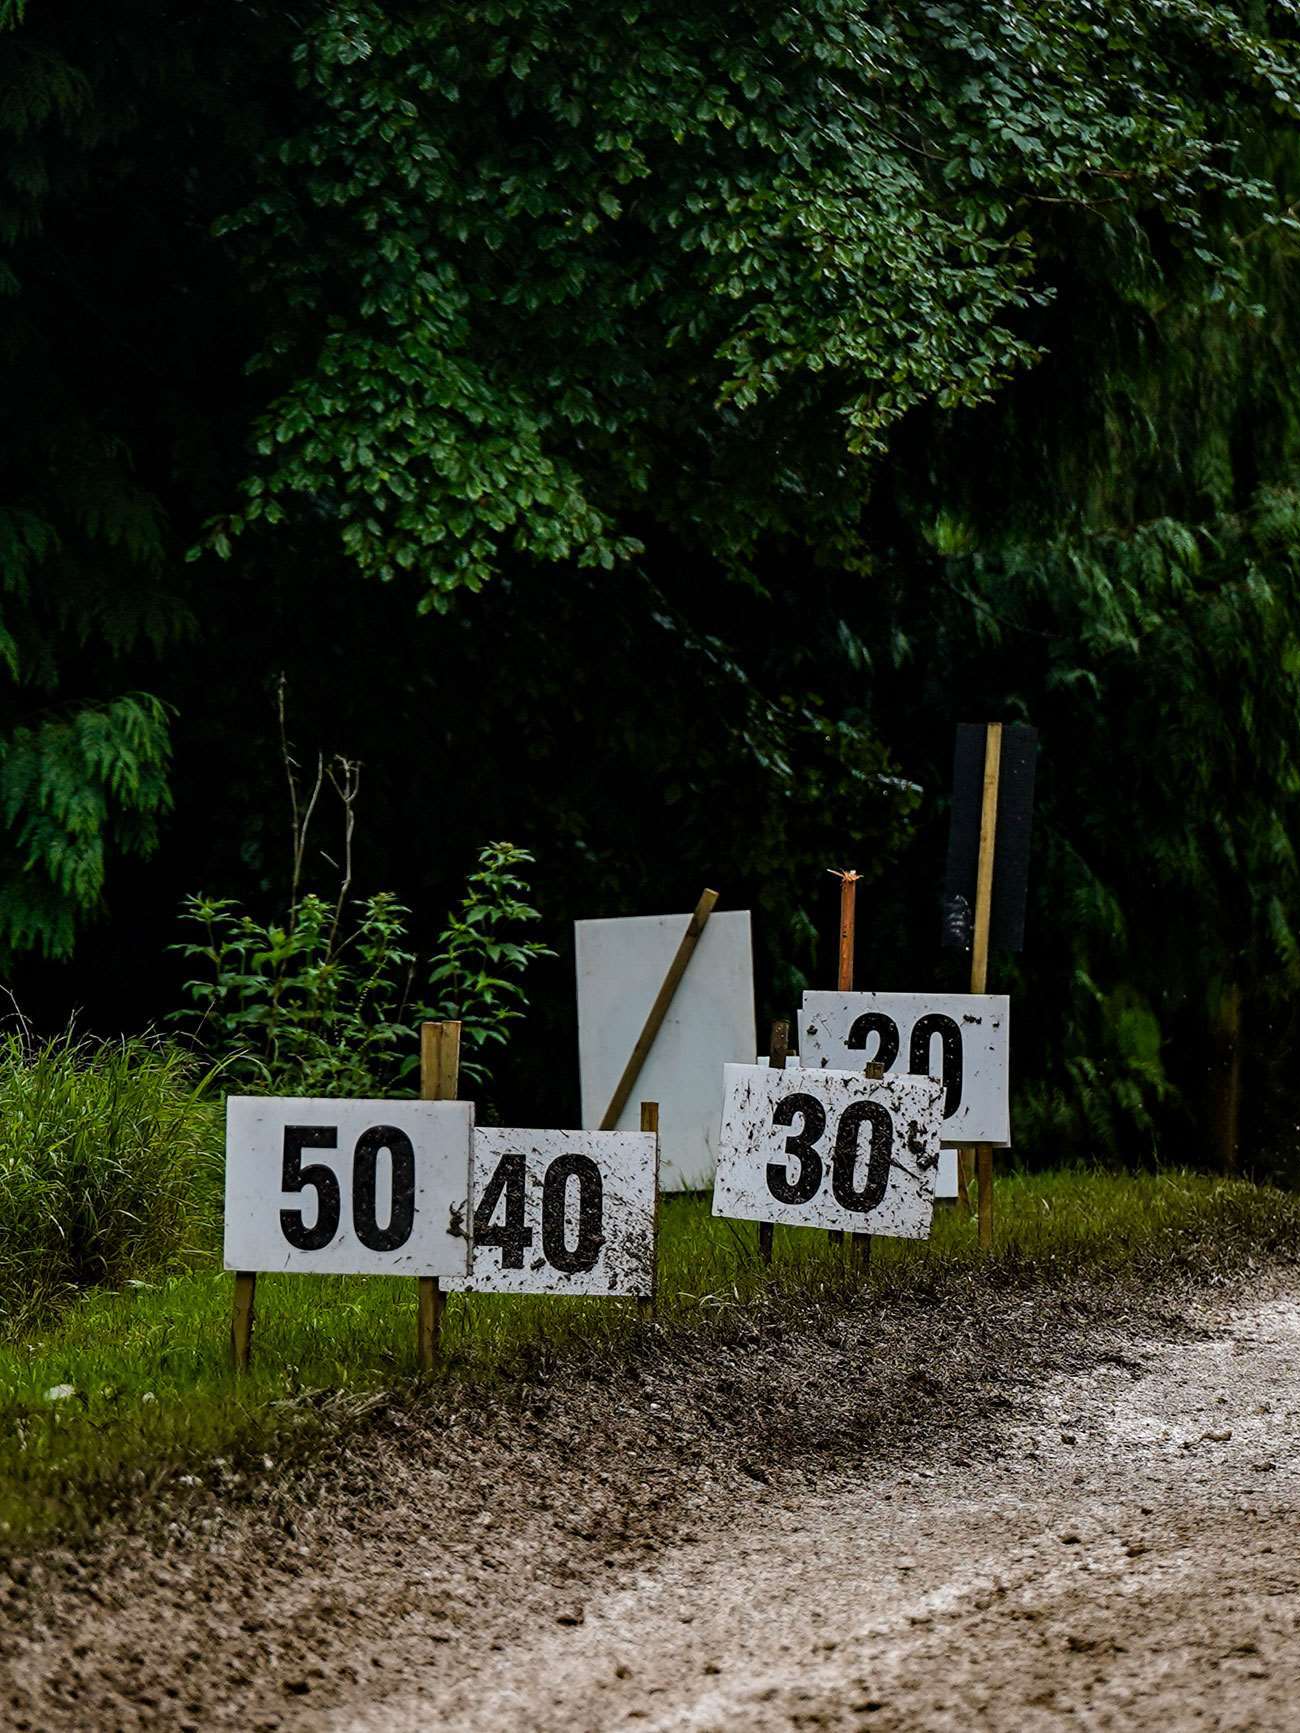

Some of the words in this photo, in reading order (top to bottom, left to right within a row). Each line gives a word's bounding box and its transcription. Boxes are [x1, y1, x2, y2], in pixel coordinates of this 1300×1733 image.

[279, 1124, 416, 1252] 50
[473, 1151, 604, 1273] 40
[766, 1092, 893, 1214] 30
